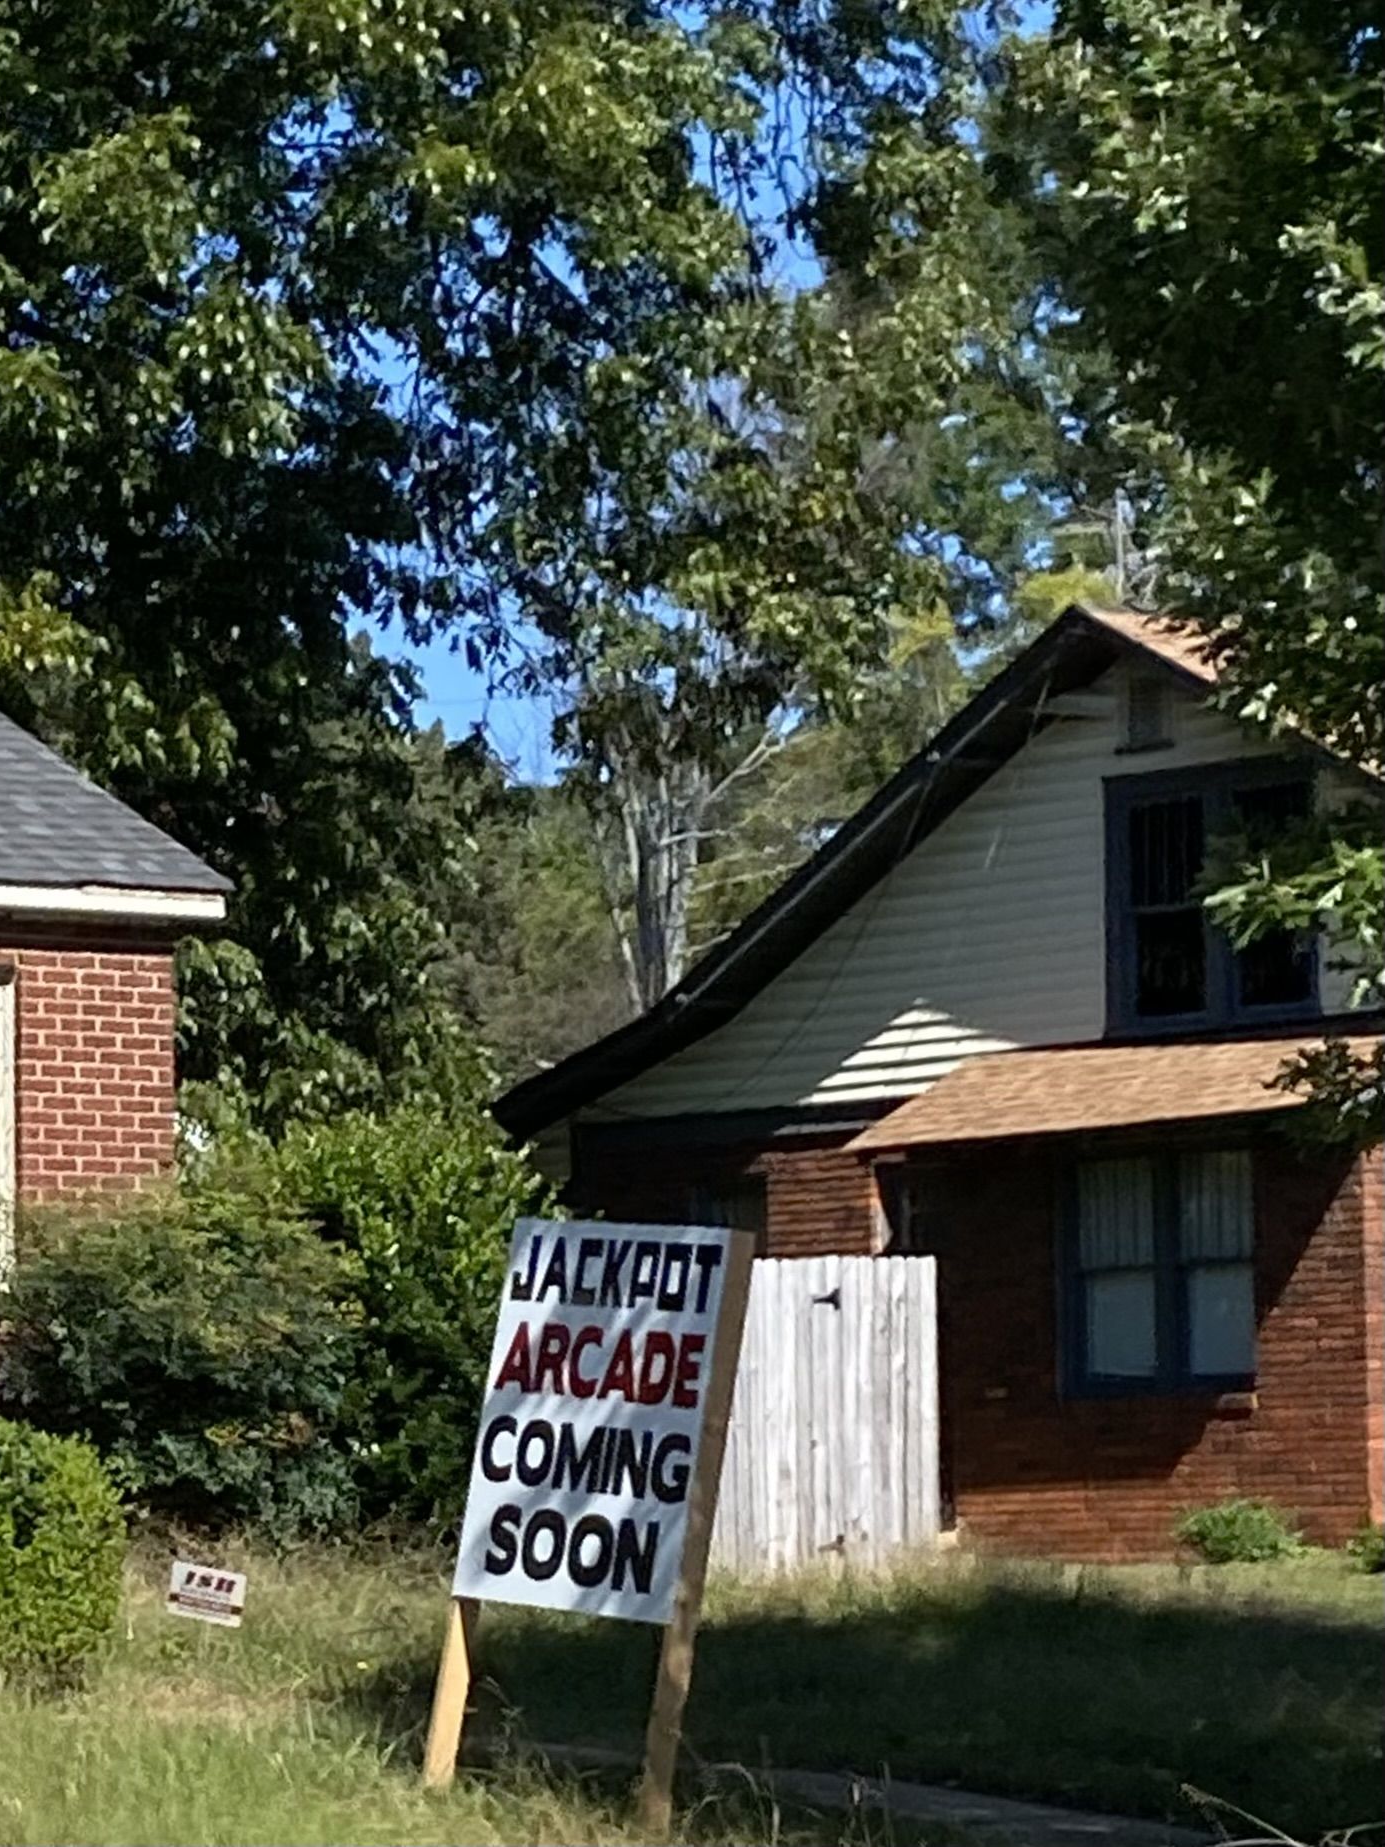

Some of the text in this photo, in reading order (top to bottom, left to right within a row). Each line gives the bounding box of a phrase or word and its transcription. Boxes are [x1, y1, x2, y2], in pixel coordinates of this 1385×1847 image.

[510, 1235, 723, 1313] JACKPOT
[494, 1321, 706, 1409] ARCADE
[480, 1415, 691, 1504] COMING
[484, 1503, 660, 1594] SOON
